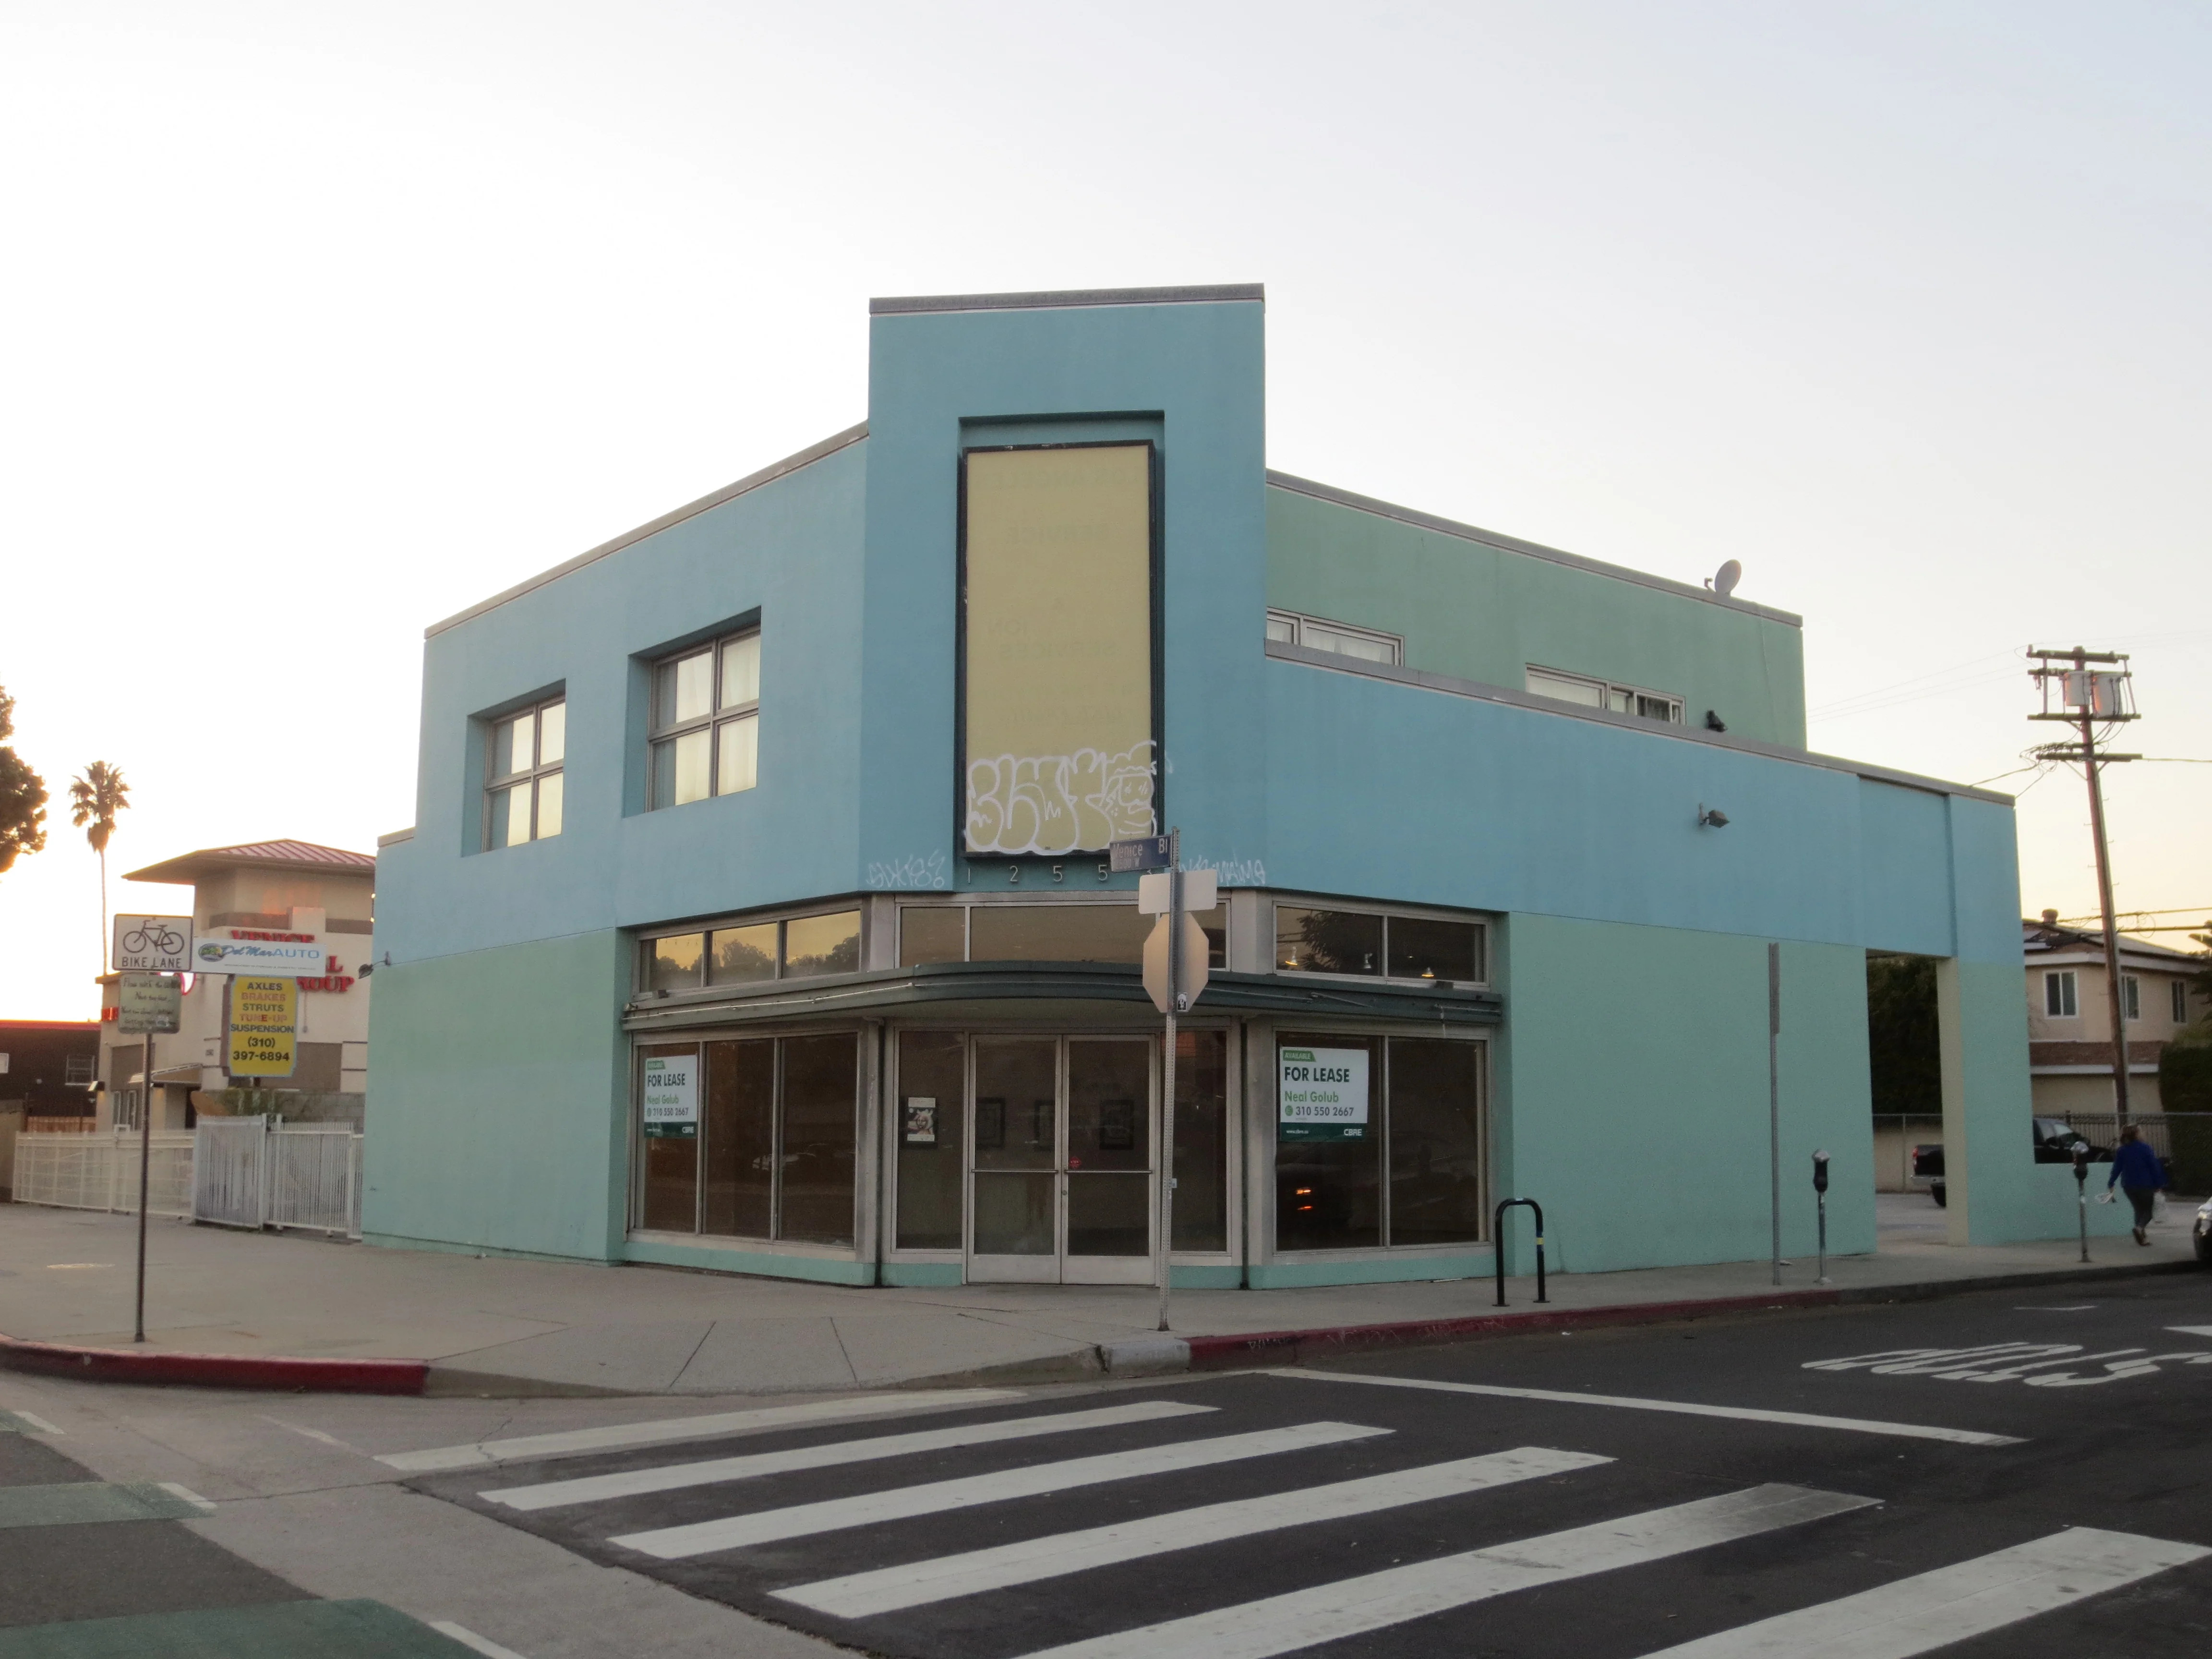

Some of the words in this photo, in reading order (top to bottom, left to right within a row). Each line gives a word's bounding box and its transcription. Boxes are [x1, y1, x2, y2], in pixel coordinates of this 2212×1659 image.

[1113, 843, 1143, 858] Venice
[273, 949, 320, 959] AUTO
[122, 956, 147, 967] BIKE
[151, 957, 182, 968] LANE
[247, 982, 283, 991] AXLES
[241, 992, 286, 1001] BRAKES
[242, 1003, 284, 1012] STRUTS
[240, 1014, 288, 1022] TUNE-UP
[230, 1023, 294, 1033] SUSPENSION
[248, 1036, 276, 1048] (310)
[233, 1050, 290, 1061] 397-6894
[1285, 1051, 1310, 1059] AVAILABLE
[1285, 1066, 1309, 1082] FOR
[1313, 1067, 1350, 1082] LEASE
[648, 1075, 662, 1087] FOR
[664, 1073, 685, 1086] LEASE
[1285, 1091, 1307, 1102] Neal
[1310, 1091, 1339, 1103] Golub
[664, 1108, 673, 1116] 550
[675, 1107, 689, 1116] 2667
[1296, 1106, 1311, 1116] 310
[1314, 1106, 1330, 1116] 550
[1333, 1106, 1354, 1117] 2667
